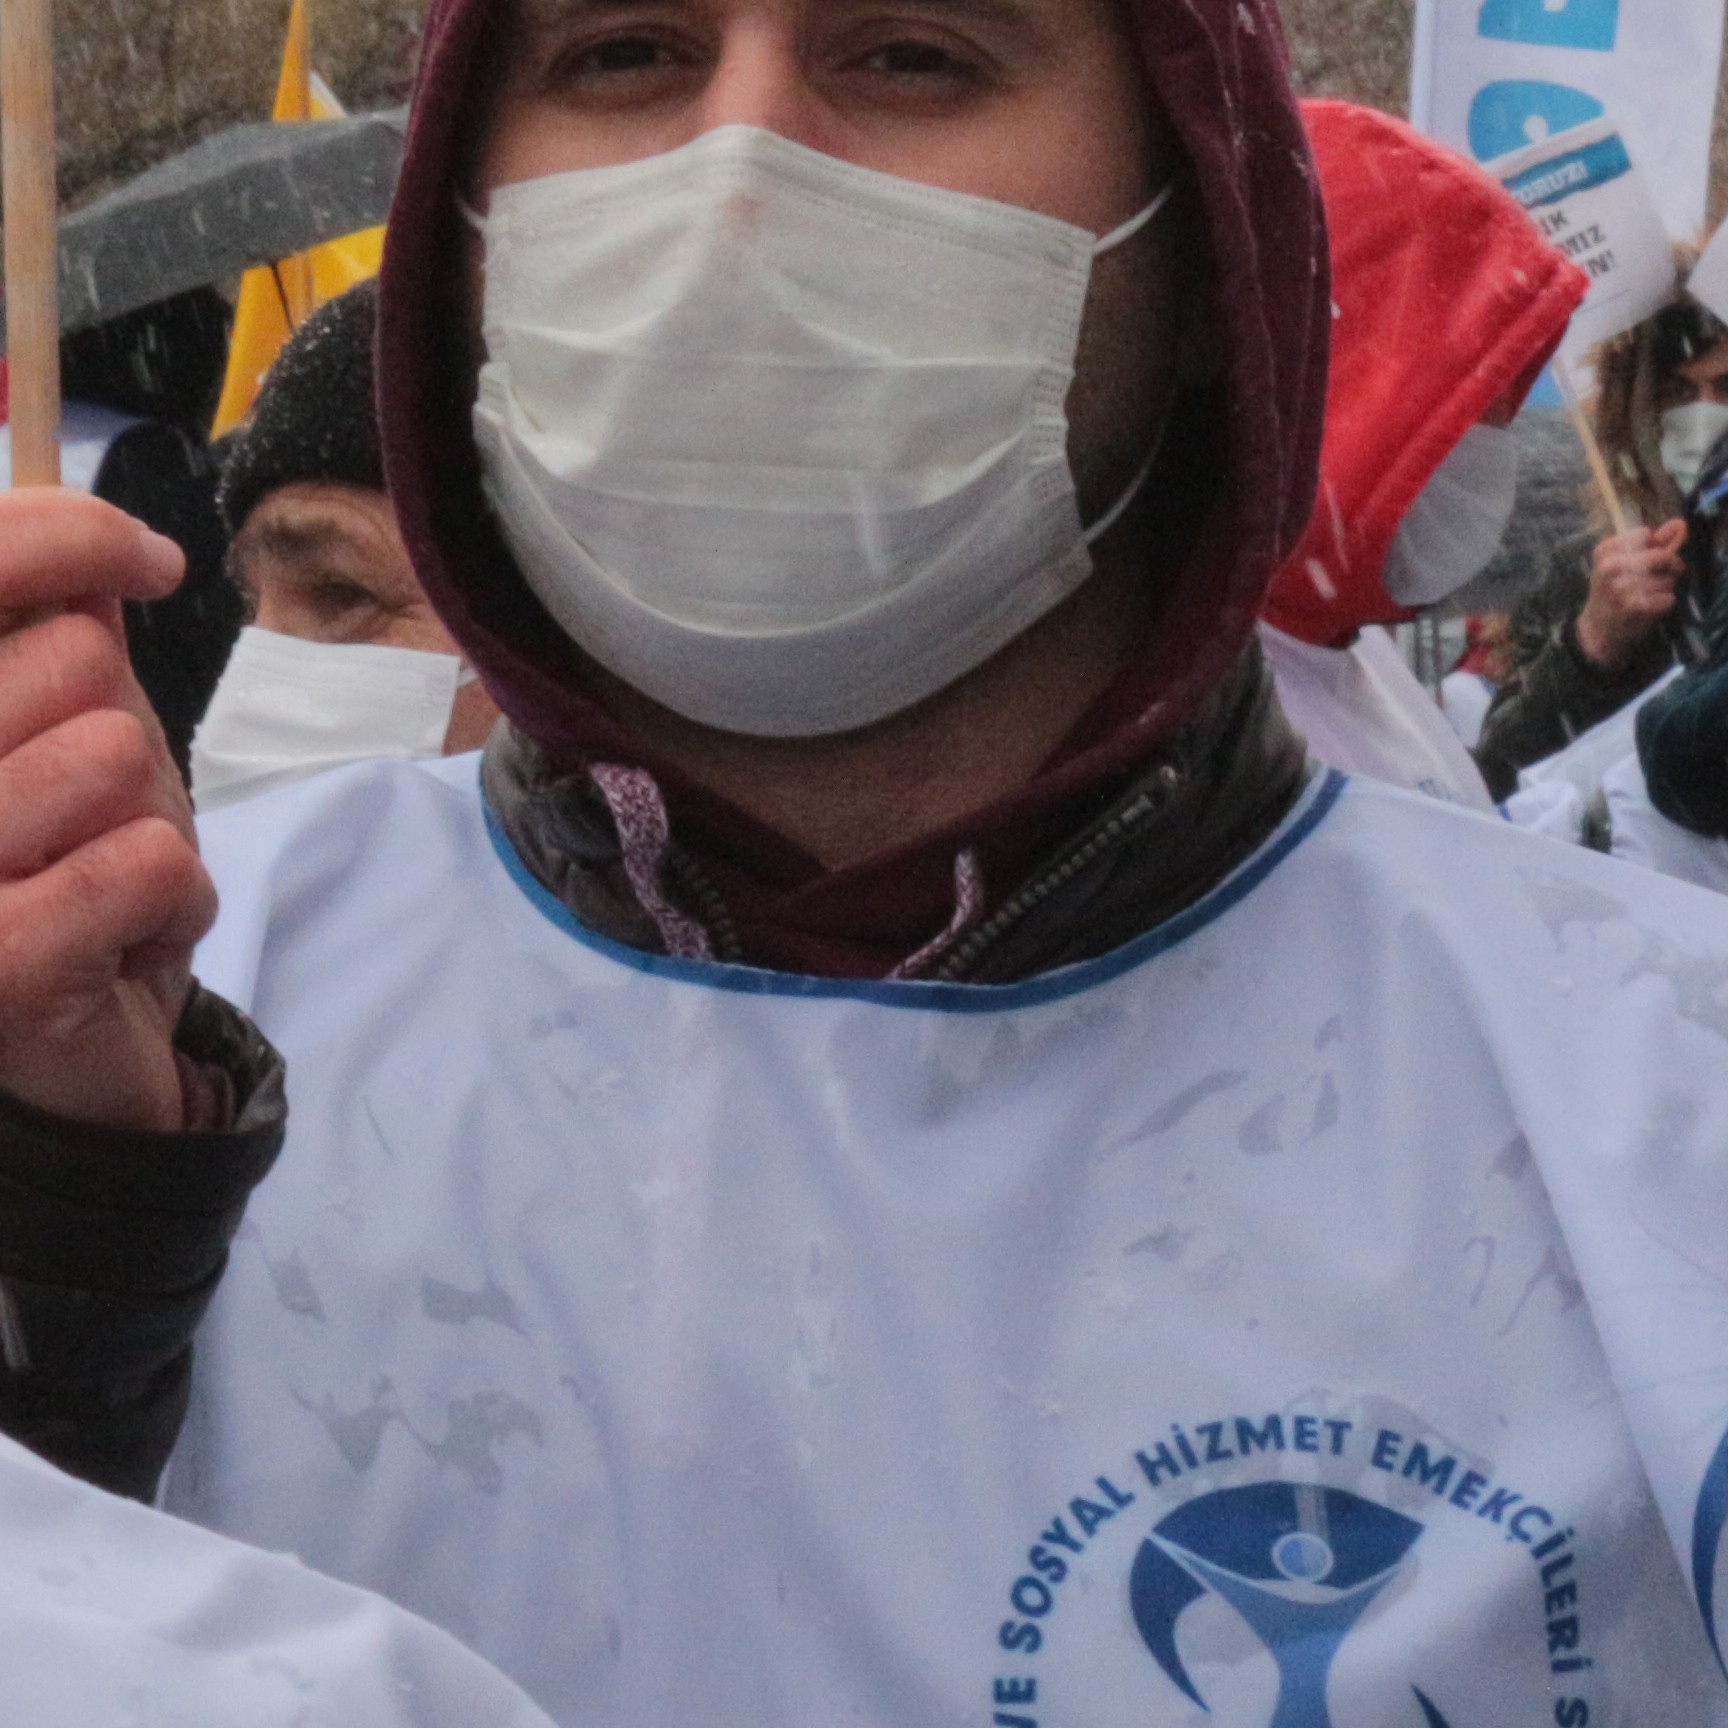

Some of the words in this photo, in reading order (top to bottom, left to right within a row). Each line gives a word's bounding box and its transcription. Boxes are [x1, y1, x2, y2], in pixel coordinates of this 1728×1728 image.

[998, 1475, 1137, 1654] SOSYAL
[1134, 1413, 1353, 1487] HİZMET
[1371, 1428, 1594, 1673] EMEKÇİLERİ
